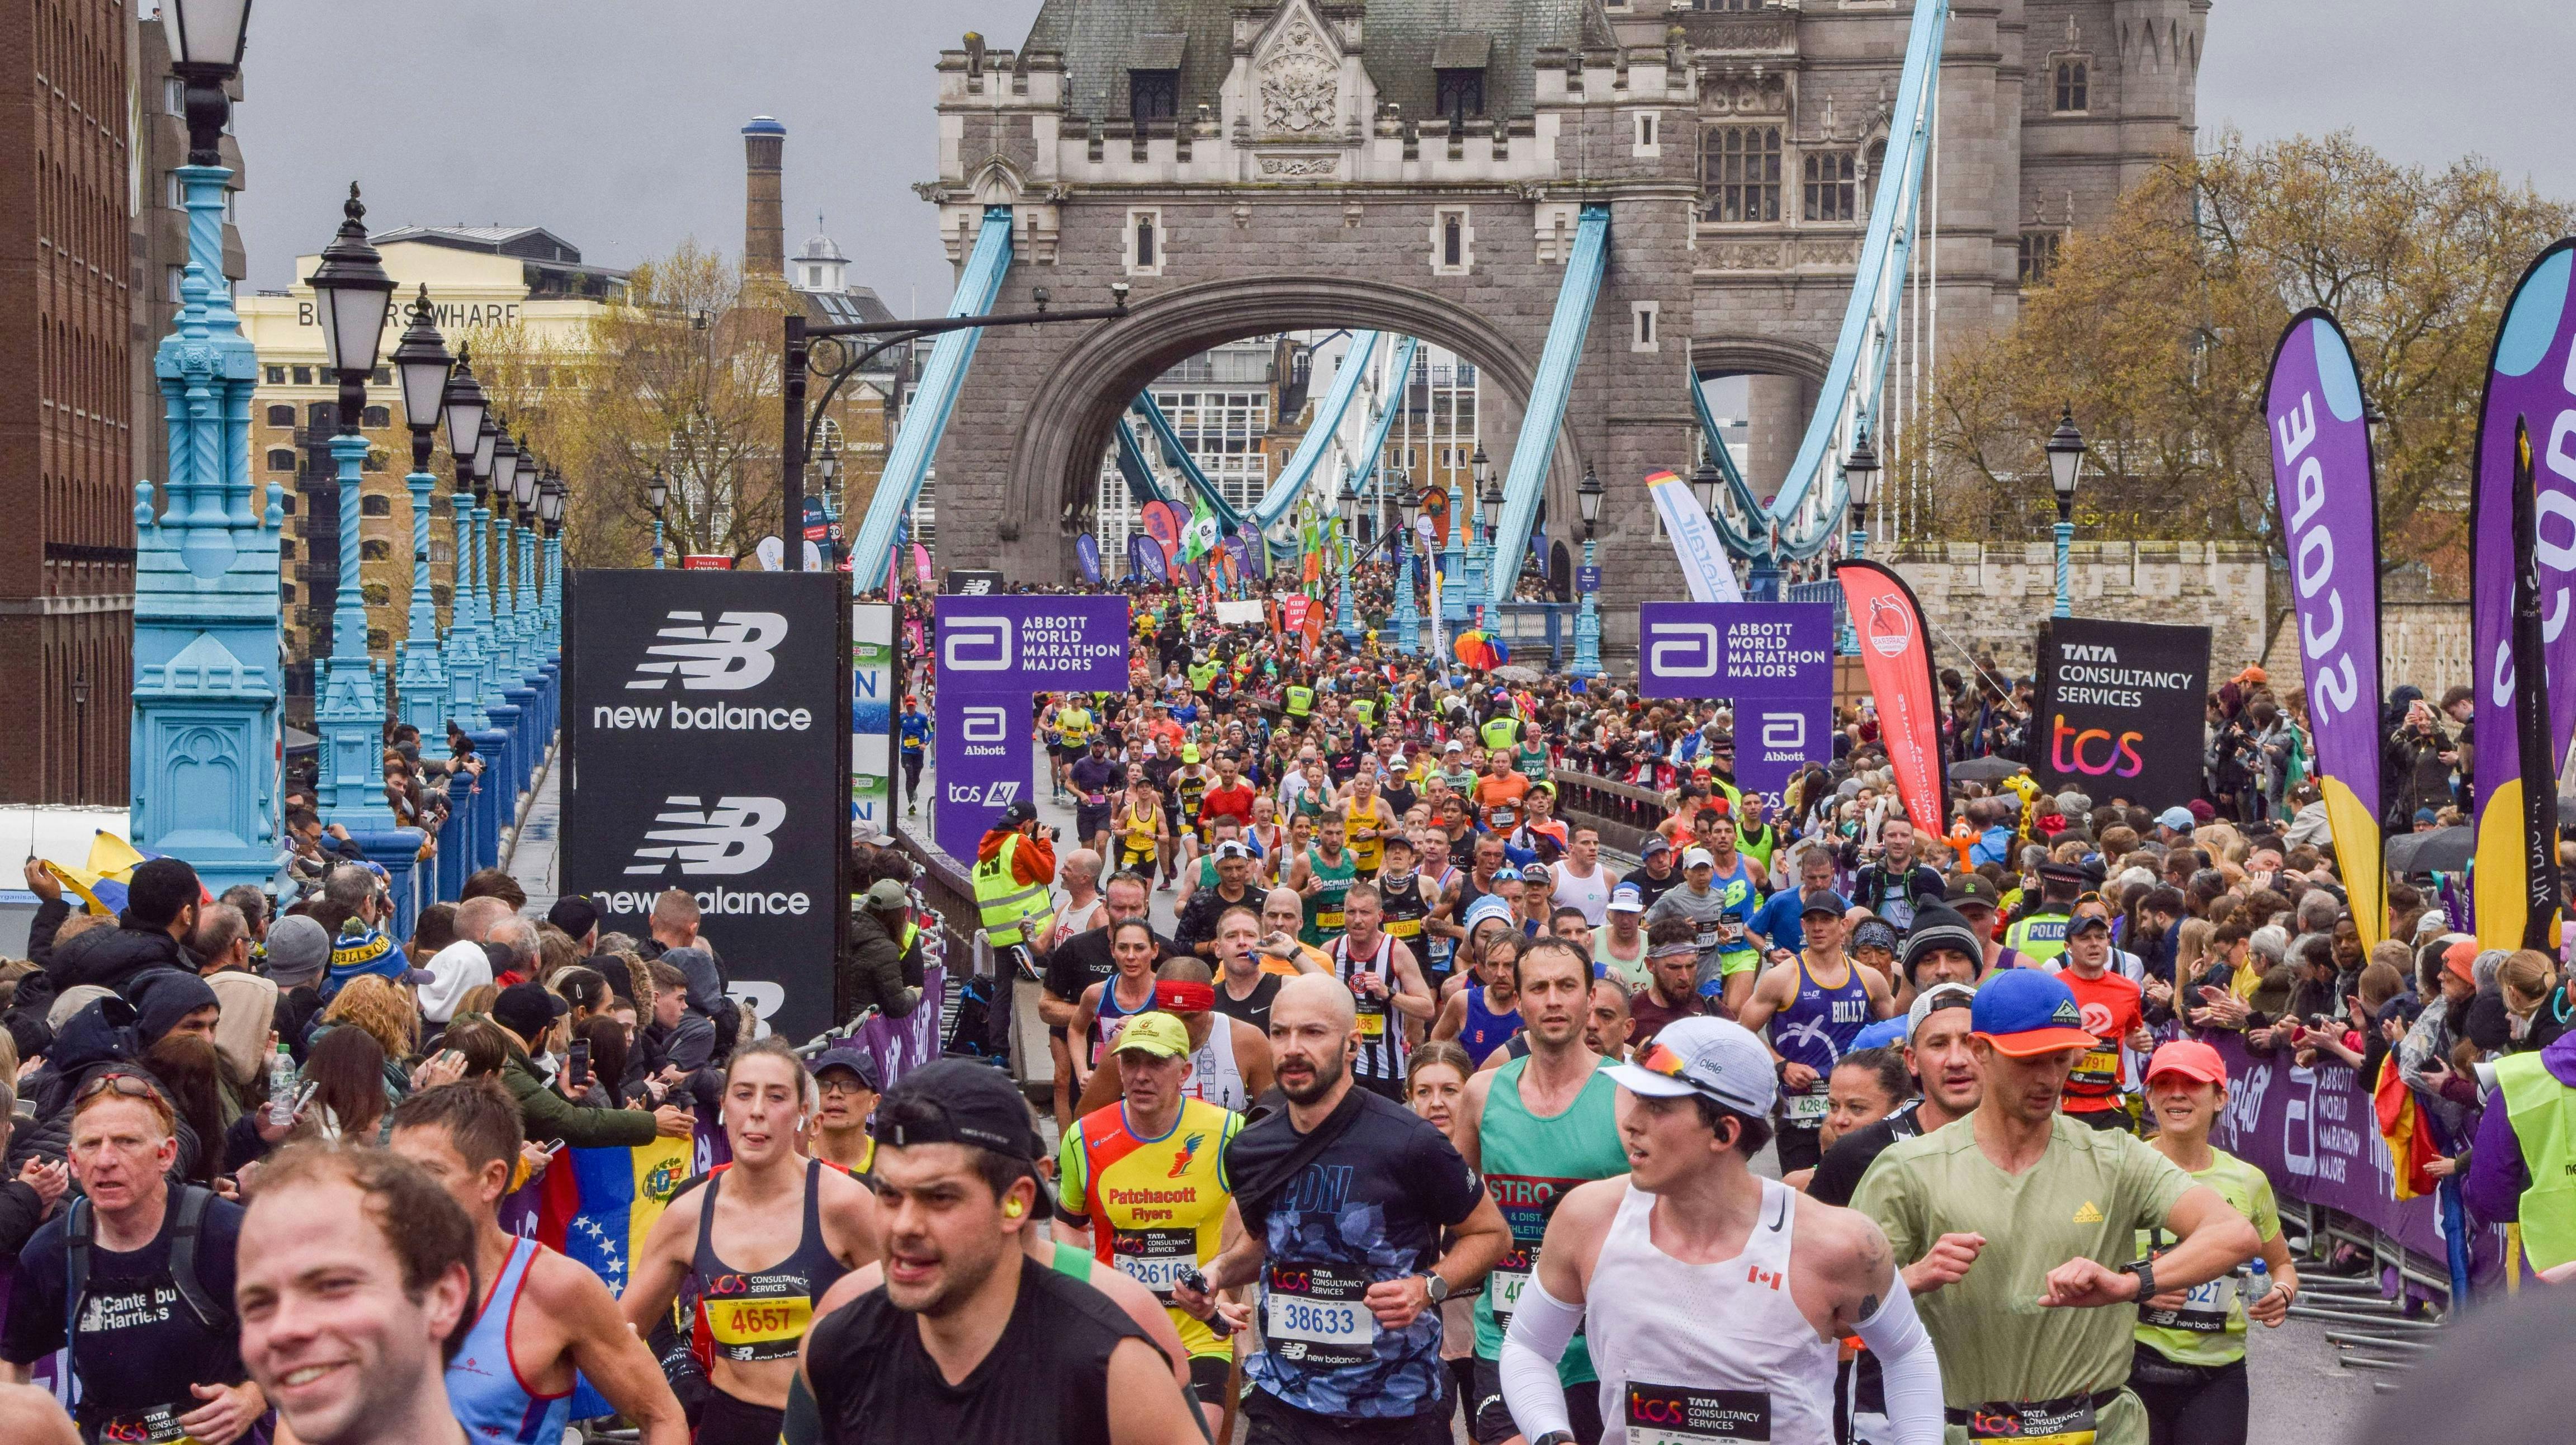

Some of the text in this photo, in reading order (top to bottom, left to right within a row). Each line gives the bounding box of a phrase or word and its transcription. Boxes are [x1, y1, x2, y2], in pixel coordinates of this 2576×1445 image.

[431, 304, 519, 328] WHARF
[1022, 616, 1088, 629] ABBOTT
[1728, 623, 1793, 636] ABBOTT
[1022, 630, 1082, 643] WORLD
[1728, 637, 1787, 649] WORLD
[1023, 644, 1121, 657] MARATHON
[1728, 650, 1826, 663] MARATHON
[2061, 644, 2118, 663] TATA
[1022, 658, 1092, 671] MAJORS
[1728, 664, 1798, 678] MAJORS
[2059, 664, 2193, 691] CONSULTANCY
[2057, 686, 2143, 708] SERVICES
[594, 701, 811, 731] new balance
[964, 745, 1006, 755] Abbott
[2052, 713, 2143, 779] tcs
[1763, 750, 1805, 762] Abbott
[949, 782, 981, 802] tcs
[593, 885, 810, 915] new alance
[1477, 908, 1504, 916] DIABETES
[1392, 924, 1412, 934] 4507
[2029, 924, 2066, 938] POLIC
[1832, 1000, 1866, 1023] BILLY
[2081, 1056, 2105, 1069] 791
[2319, 1066, 2354, 1093] ABBOTT
[2319, 1094, 2348, 1122] WORLD
[2319, 1124, 2360, 1158] MARATHON
[2319, 1156, 2346, 1184] MAJORS
[1109, 1187, 1196, 1205] Patchacott
[1490, 1179, 1554, 1203] STRO
[1131, 1207, 1173, 1222] Flyers
[1511, 1212, 1517, 1220] &
[2073, 1213, 2104, 1223] adidas
[751, 1275, 809, 1286] CONSULTANCY
[1273, 1266, 1309, 1291] tcs
[1312, 1269, 1332, 1278] TATA
[710, 1274, 747, 1294] tcs
[751, 1284, 786, 1293] SERVICES
[1312, 1277, 1364, 1288] CONSULTANCY
[1312, 1286, 1344, 1296] SERVICES
[731, 1307, 790, 1335] 4657
[1284, 1304, 1354, 1334] 38633
[1325, 1355, 1362, 1364] balance
[1633, 1392, 1682, 1424] tcs
[1688, 1397, 1719, 1408] TATA
[144, 1411, 170, 1423] TATA
[1688, 1408, 1760, 1423] CONSULTANCY
[1974, 1411, 2020, 1433] tcs
[2024, 1409, 2085, 1426] CONSULTANCY
[107, 1416, 148, 1441] tcs
[1688, 1418, 1734, 1430] SERVICES
[2024, 1423, 2063, 1434] SERVICES
[151, 1426, 182, 1440] SERVICES
